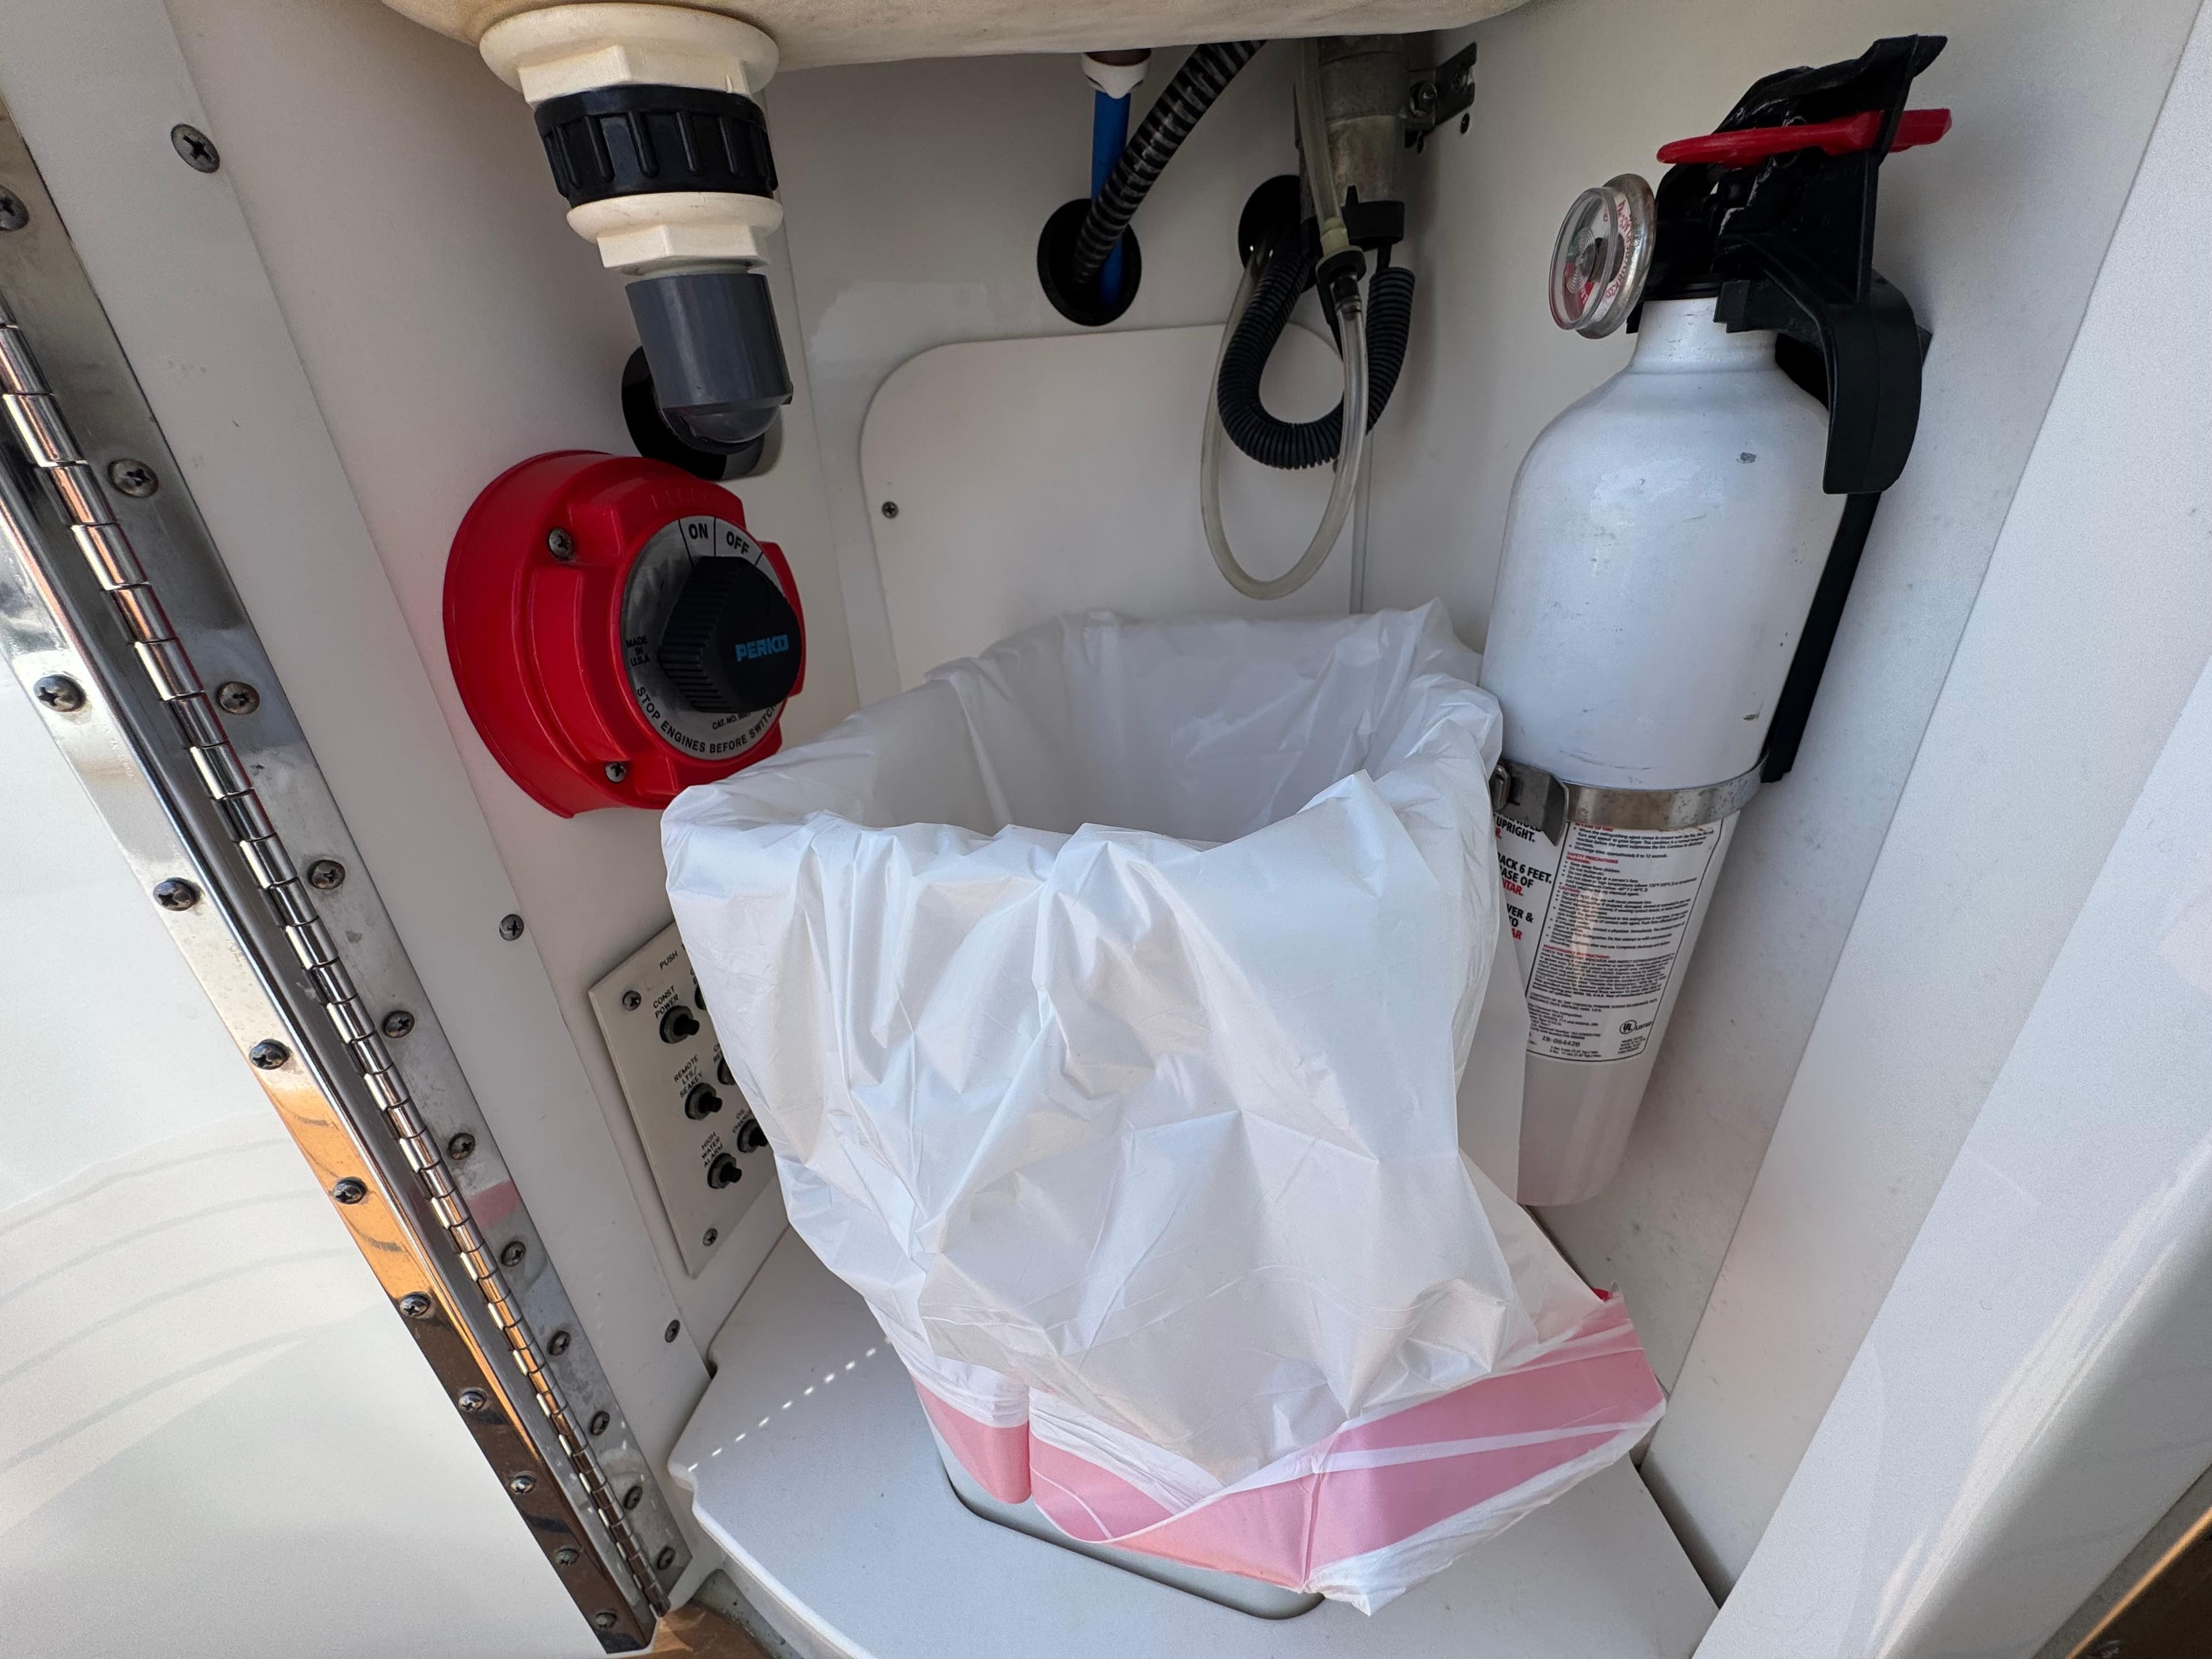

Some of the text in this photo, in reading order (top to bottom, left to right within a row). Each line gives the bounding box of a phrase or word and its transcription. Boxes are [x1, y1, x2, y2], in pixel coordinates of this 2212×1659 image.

[688, 523, 709, 540] ON
[726, 531, 749, 555] OFF
[626, 635, 649, 649] MADE
[635, 645, 644, 656] IN
[734, 634, 789, 662] PERKO
[637, 686, 661, 720] STOP
[660, 720, 706, 753] ENGINES
[709, 734, 748, 753] BEFORE
[1496, 816, 1535, 843] UPRIGHT.
[1519, 864, 1526, 874] 6
[1527, 866, 1552, 884] FEET.
[1520, 876, 1534, 888] OF
[1525, 912, 1534, 923] &
[660, 950, 678, 970] PUSH
[653, 984, 675, 1009] CONST
[655, 994, 679, 1019] POWER
[673, 1054, 699, 1083] REMOTE
[702, 1131, 716, 1150] HIGH
[702, 1136, 720, 1159] WATER
[704, 1143, 724, 1168] ALARM
